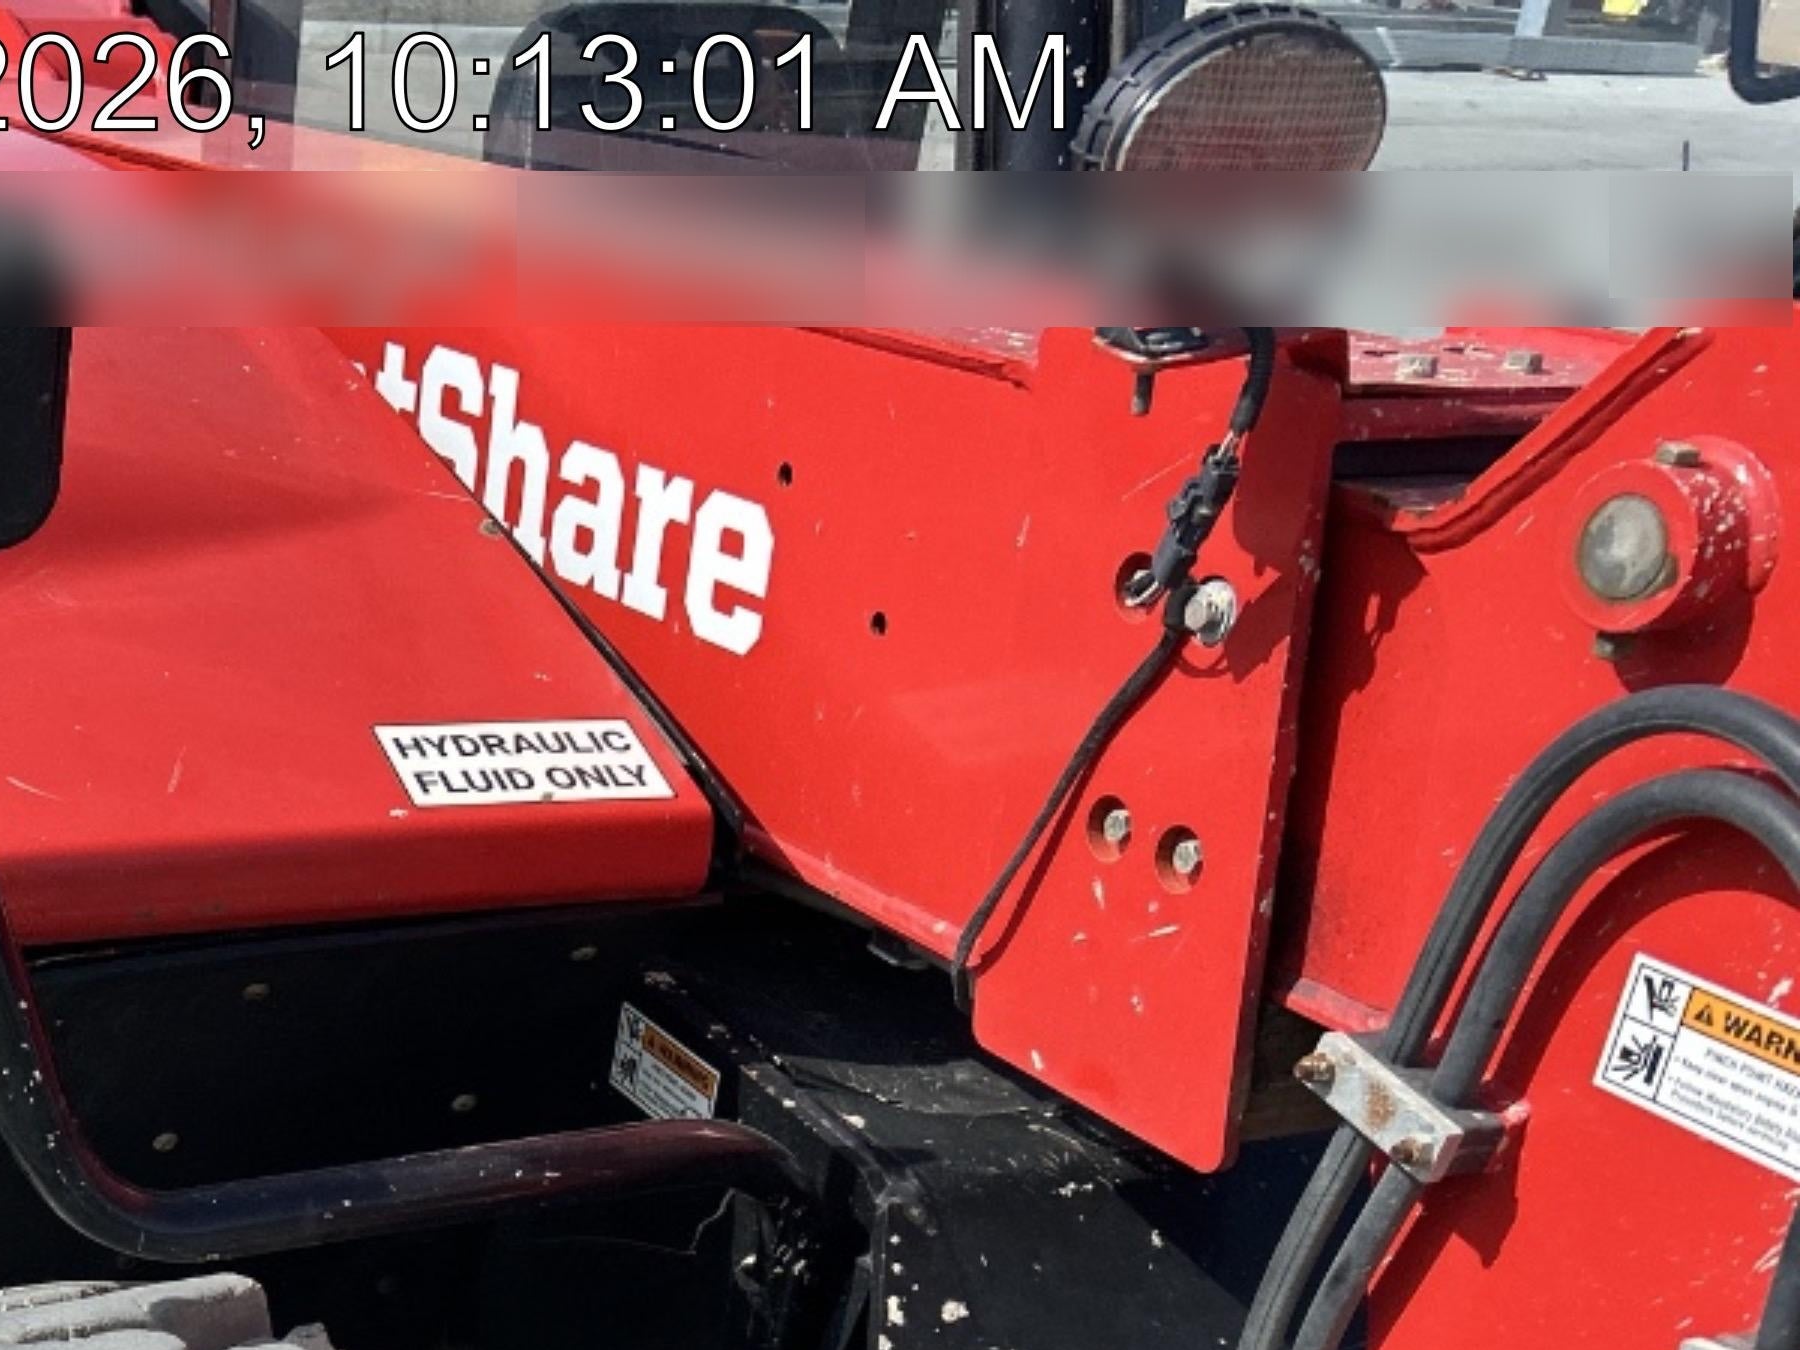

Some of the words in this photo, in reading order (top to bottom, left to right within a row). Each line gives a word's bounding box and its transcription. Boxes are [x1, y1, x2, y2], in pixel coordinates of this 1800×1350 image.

[393, 730, 632, 759] HYDRAULIC
[413, 766, 535, 795] FLUID
[545, 764, 650, 791] ONLY
